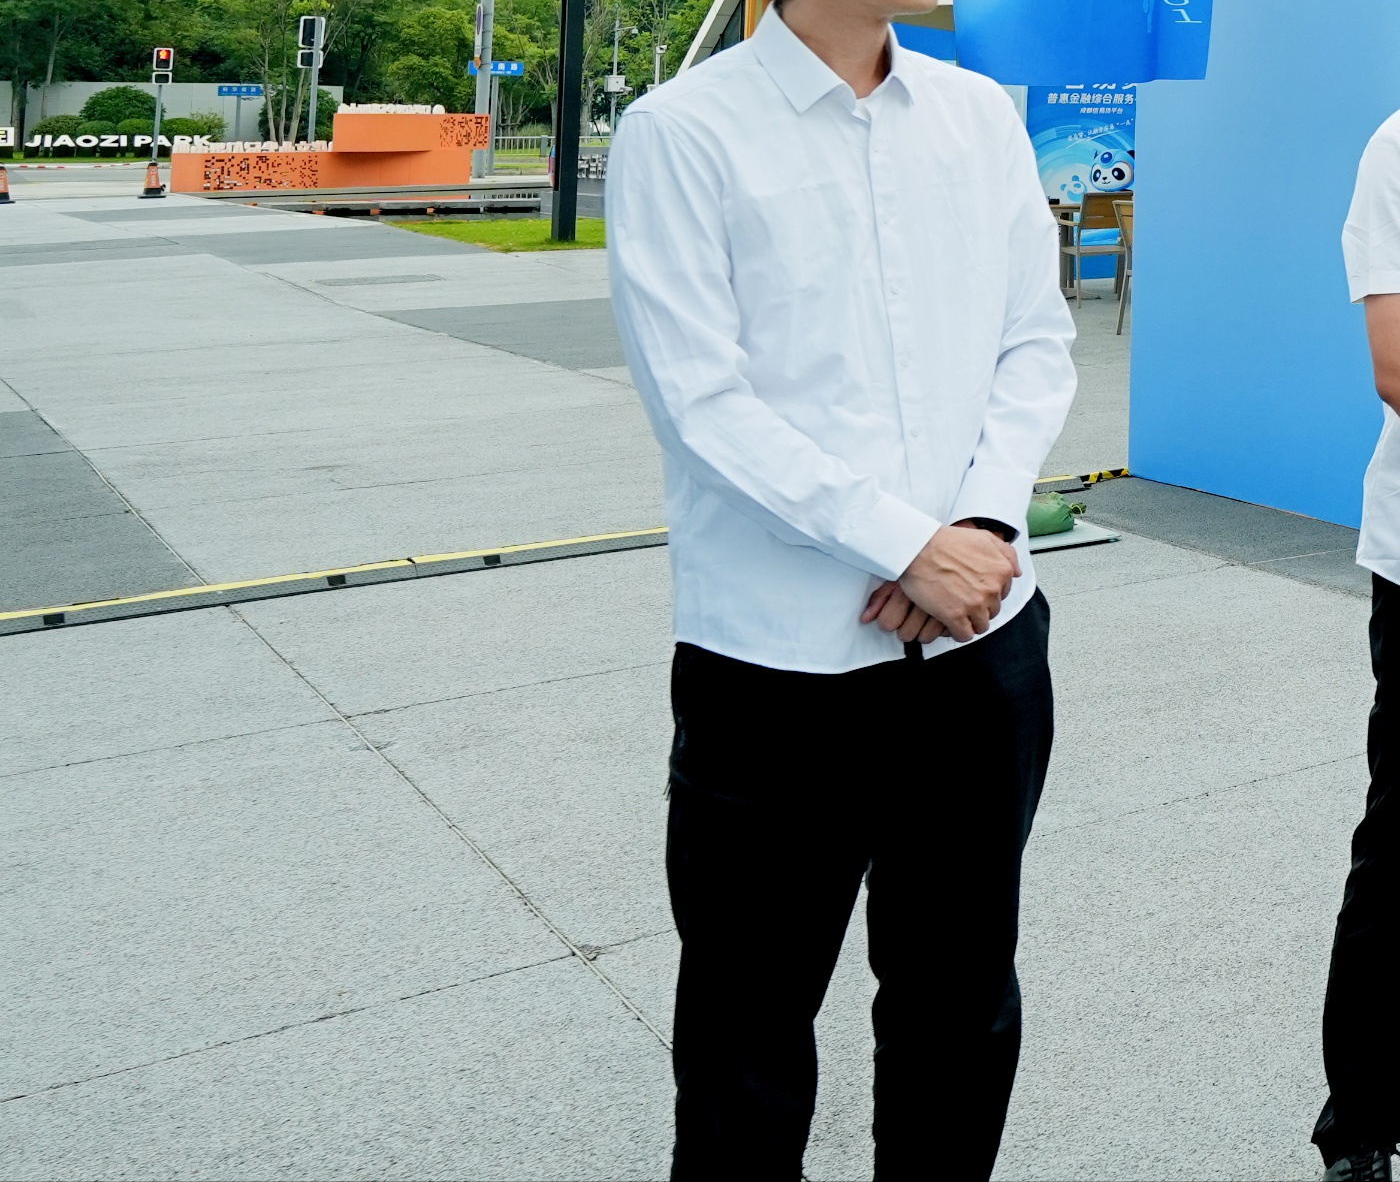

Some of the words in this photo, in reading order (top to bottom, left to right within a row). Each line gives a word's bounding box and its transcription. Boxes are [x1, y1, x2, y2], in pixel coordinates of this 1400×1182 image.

[1047, 93, 1136, 104] 普惠金融综合服务
[25, 134, 128, 148] JIAOZI
[133, 134, 213, 148] PARK
